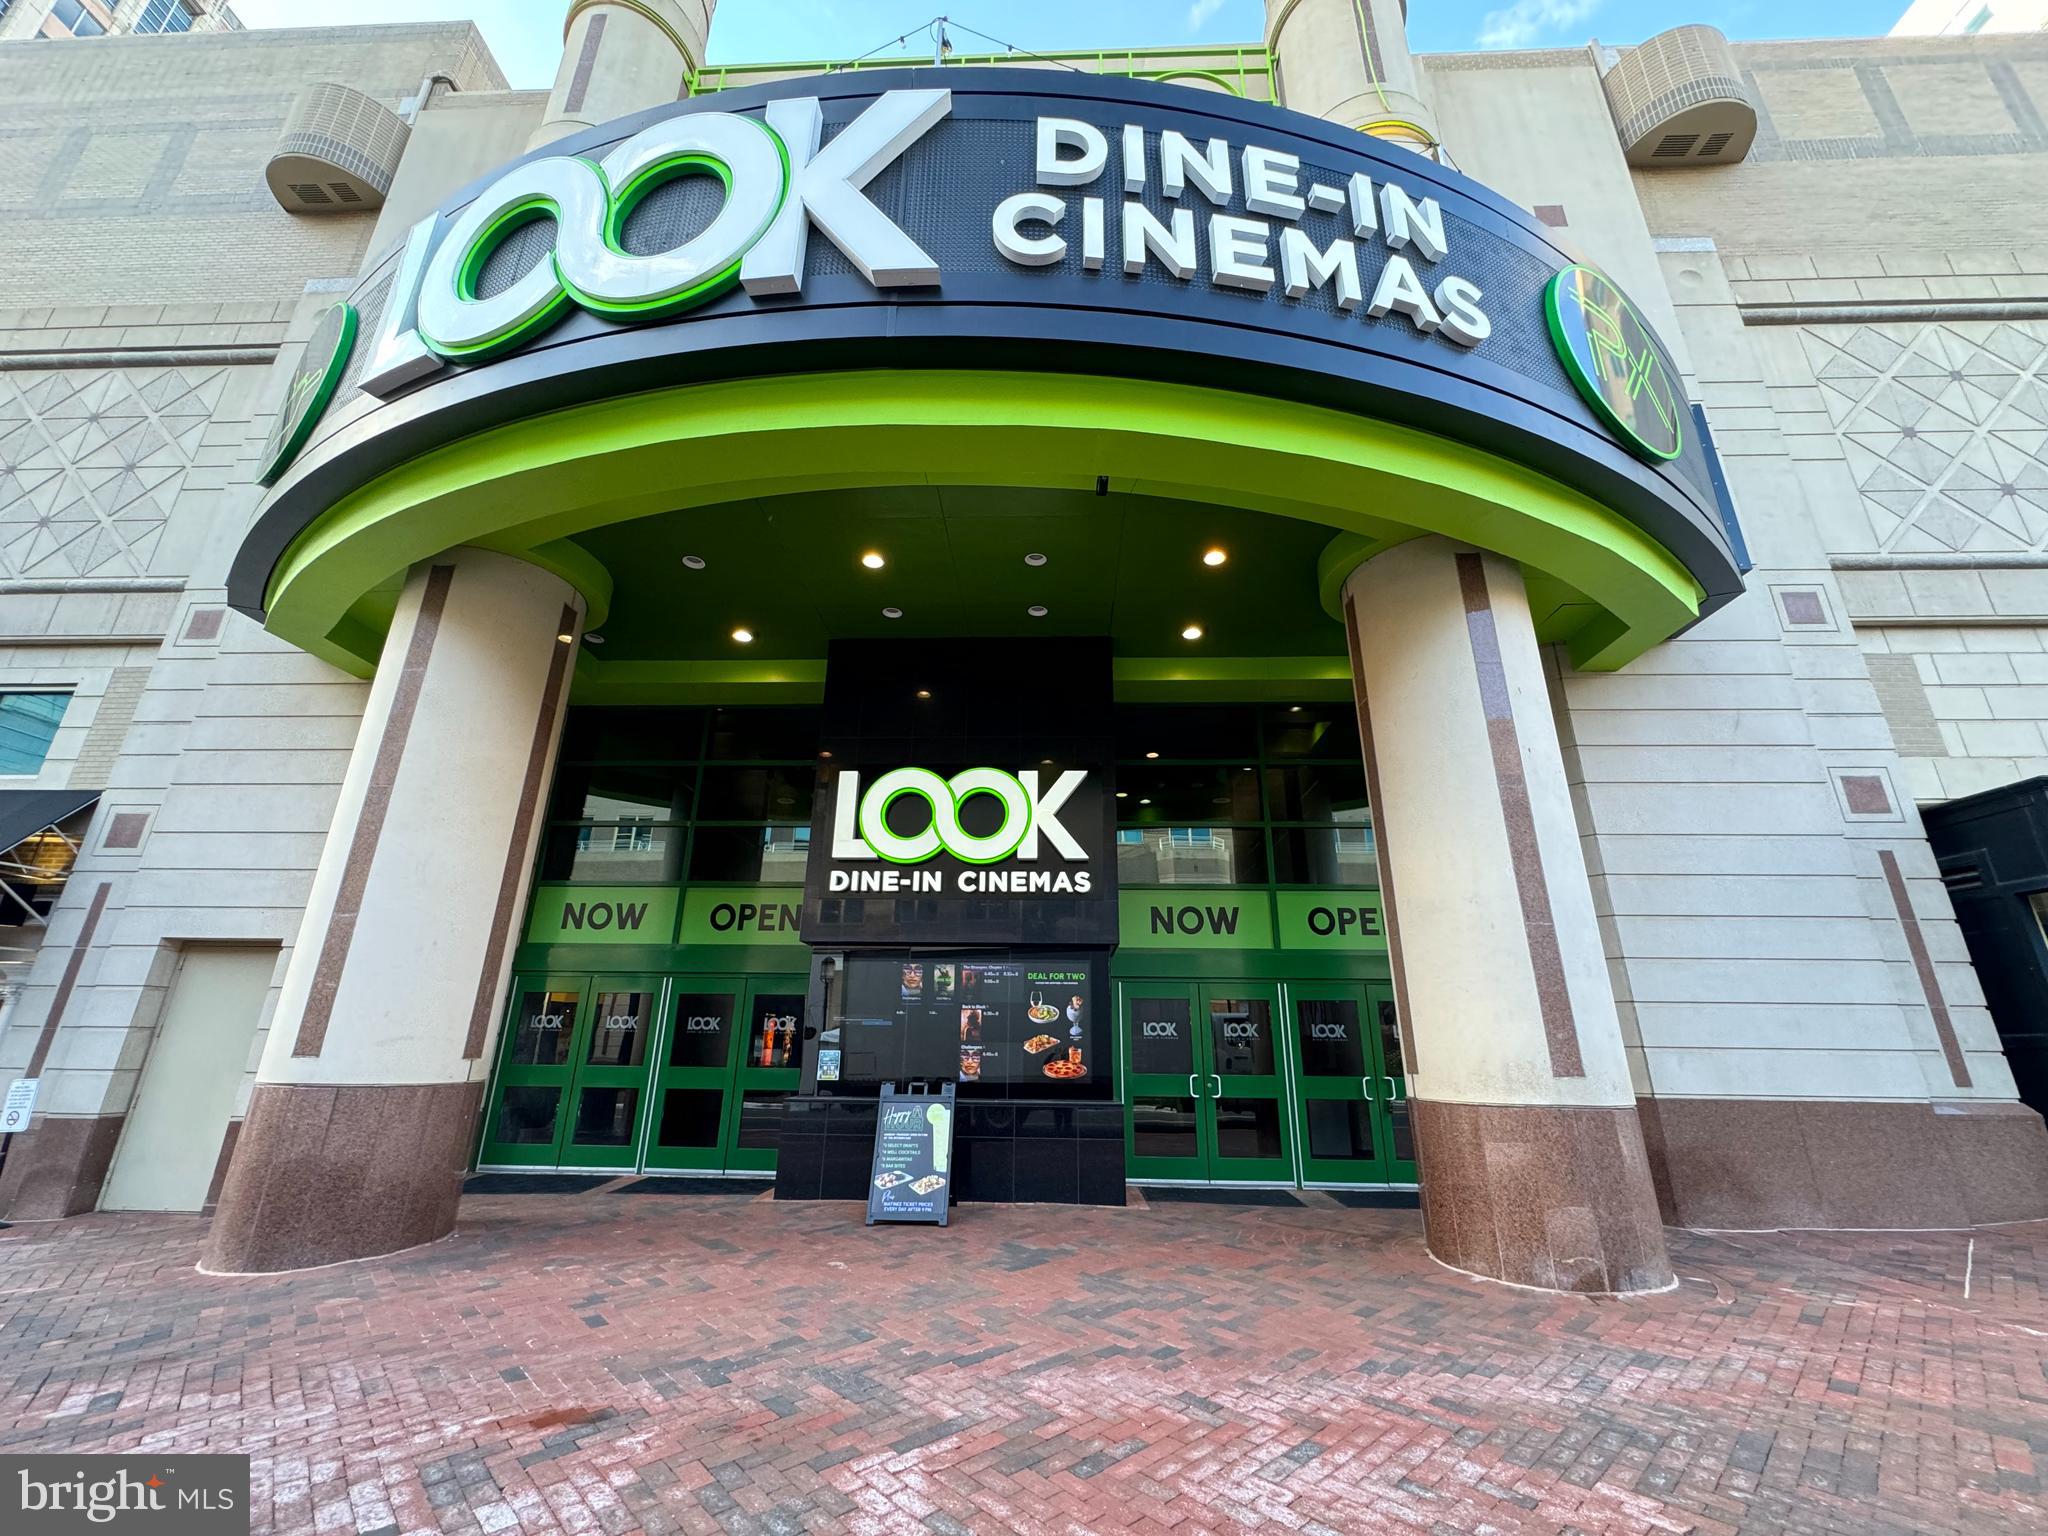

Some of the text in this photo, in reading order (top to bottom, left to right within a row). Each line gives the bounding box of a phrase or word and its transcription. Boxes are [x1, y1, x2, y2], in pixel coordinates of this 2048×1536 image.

[1035, 116, 1449, 264] DINE-IN
[358, 88, 952, 398] LOOK
[992, 193, 1492, 347] CINEMAS
[831, 767, 1090, 865] LOOK
[829, 870, 1092, 893] DINE-IN CINEMAS
[560, 902, 649, 930] NOW
[710, 903, 801, 932] OPEN
[1150, 905, 1240, 935] NOW
[1027, 972, 1048, 980] DEAL
[1049, 972, 1065, 980] FOR
[1066, 972, 1086, 980] TWO
[530, 1014, 564, 1028] LOOK
[605, 1015, 639, 1029] LOOK
[687, 1016, 721, 1031] LOOK
[1143, 1022, 1178, 1036] LOOK
[1223, 1023, 1259, 1037] LOOK
[1311, 1024, 1347, 1038] LOOK
